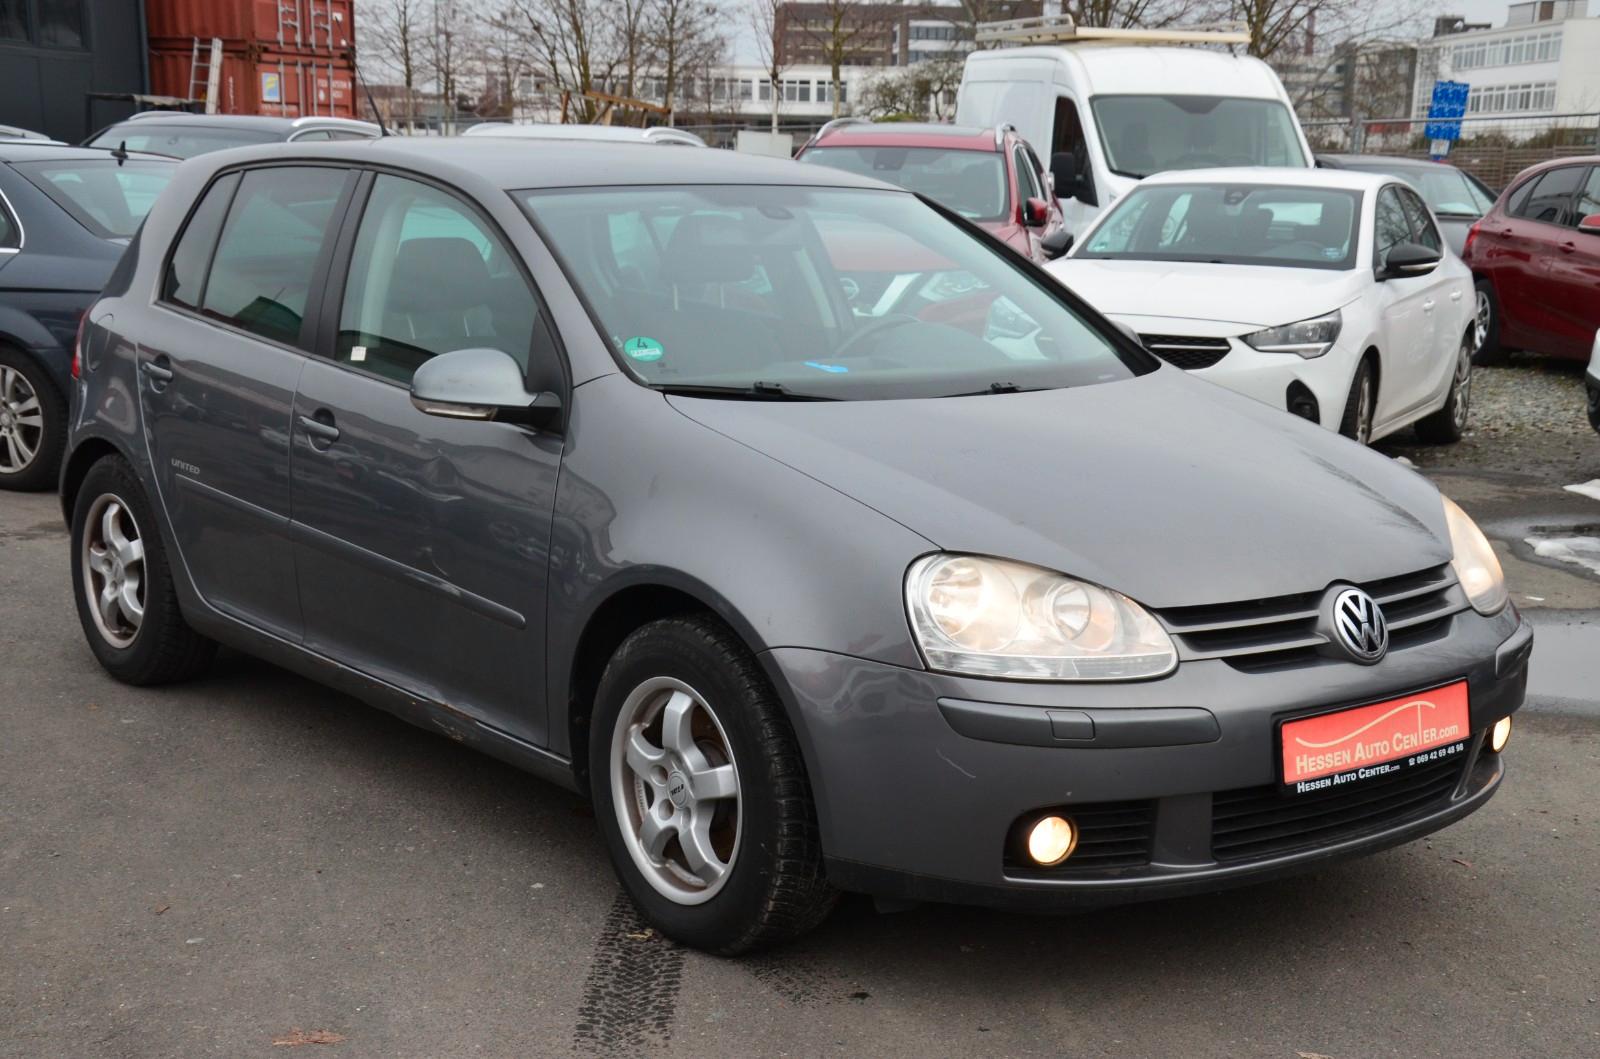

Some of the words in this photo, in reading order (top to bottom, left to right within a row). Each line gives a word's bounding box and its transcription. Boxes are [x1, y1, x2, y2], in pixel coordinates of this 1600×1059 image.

[636, 338, 648, 349] 4
[171, 457, 201, 474] UNITED
[1416, 753, 1429, 764] 069
[1430, 750, 1438, 760] 42
[1438, 748, 1447, 758] 69
